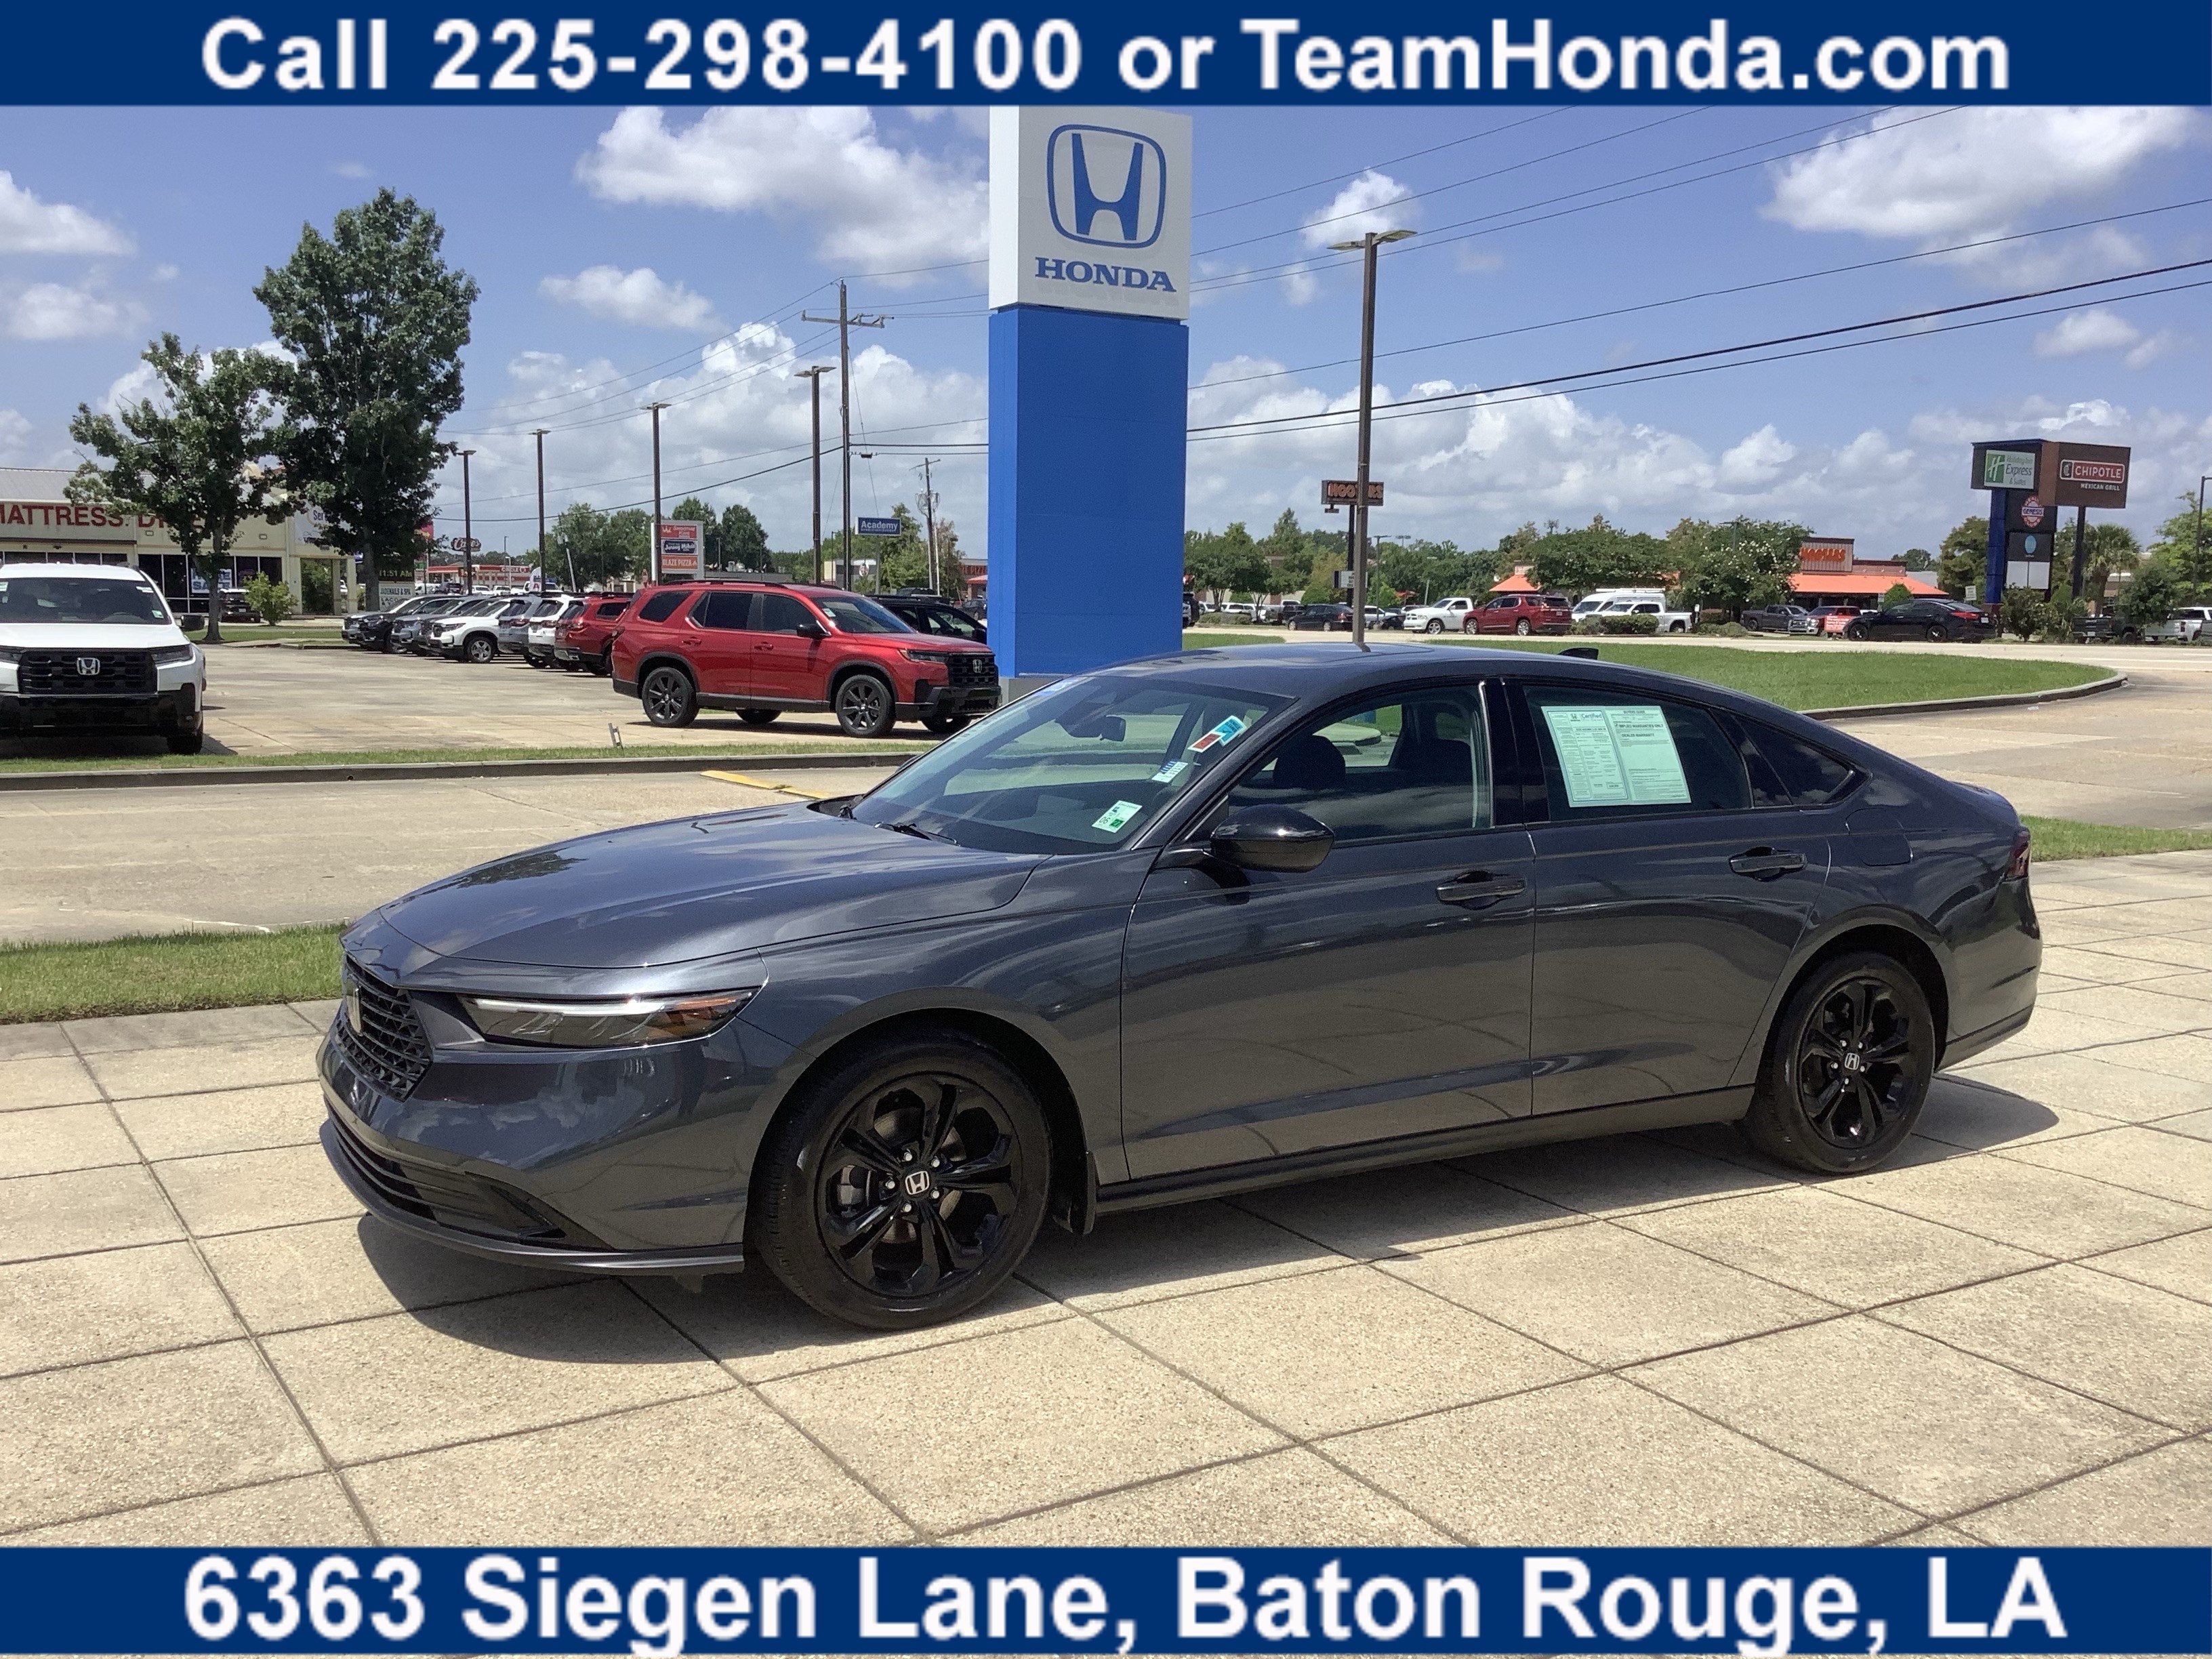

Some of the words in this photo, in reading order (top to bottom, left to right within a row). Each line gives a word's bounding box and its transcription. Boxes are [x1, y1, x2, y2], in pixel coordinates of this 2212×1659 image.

[1035, 257, 1177, 293] HONDA
[2006, 464, 2032, 476] Express
[2074, 466, 2122, 478] CHIPOTLE
[861, 520, 898, 531] Academy
